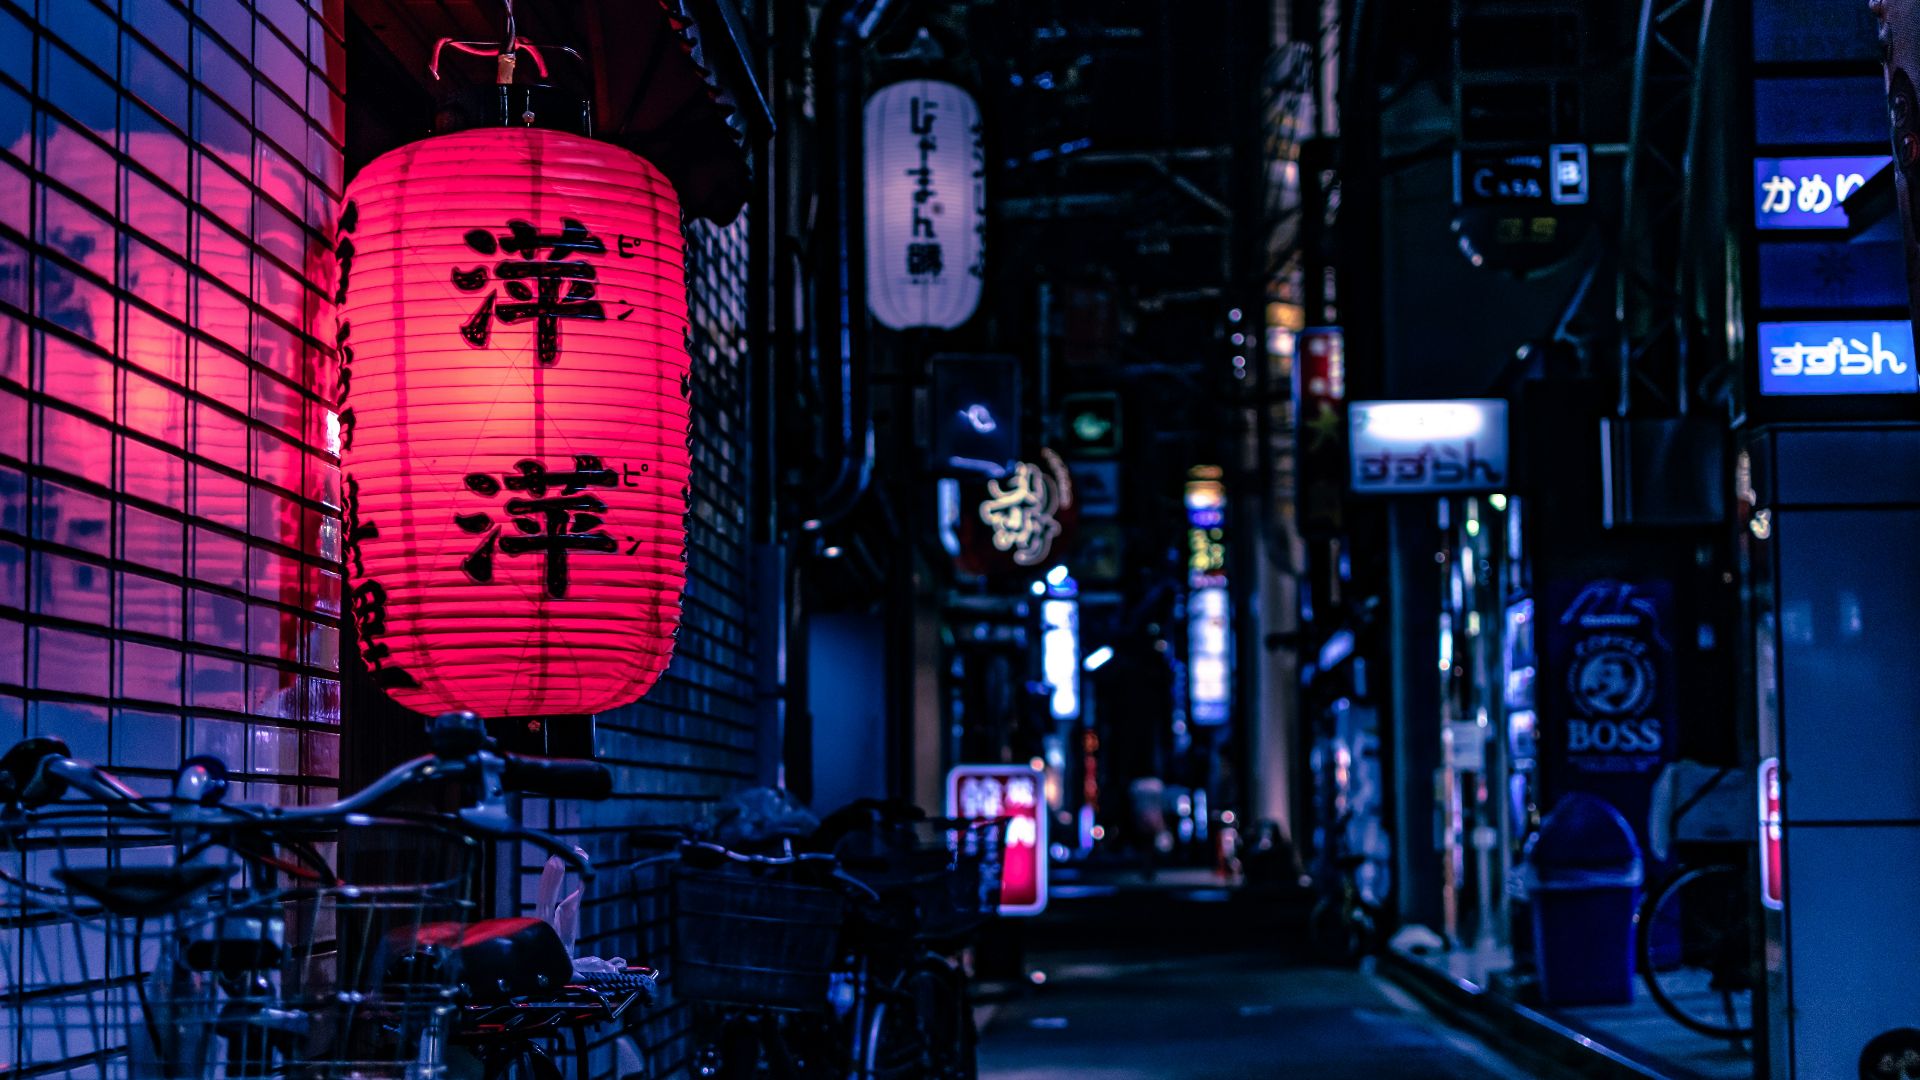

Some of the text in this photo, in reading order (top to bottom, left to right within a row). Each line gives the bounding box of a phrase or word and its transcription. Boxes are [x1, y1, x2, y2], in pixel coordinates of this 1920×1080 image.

[1770, 332, 1907, 376] すずらん
[1567, 719, 1662, 752] BOSS
